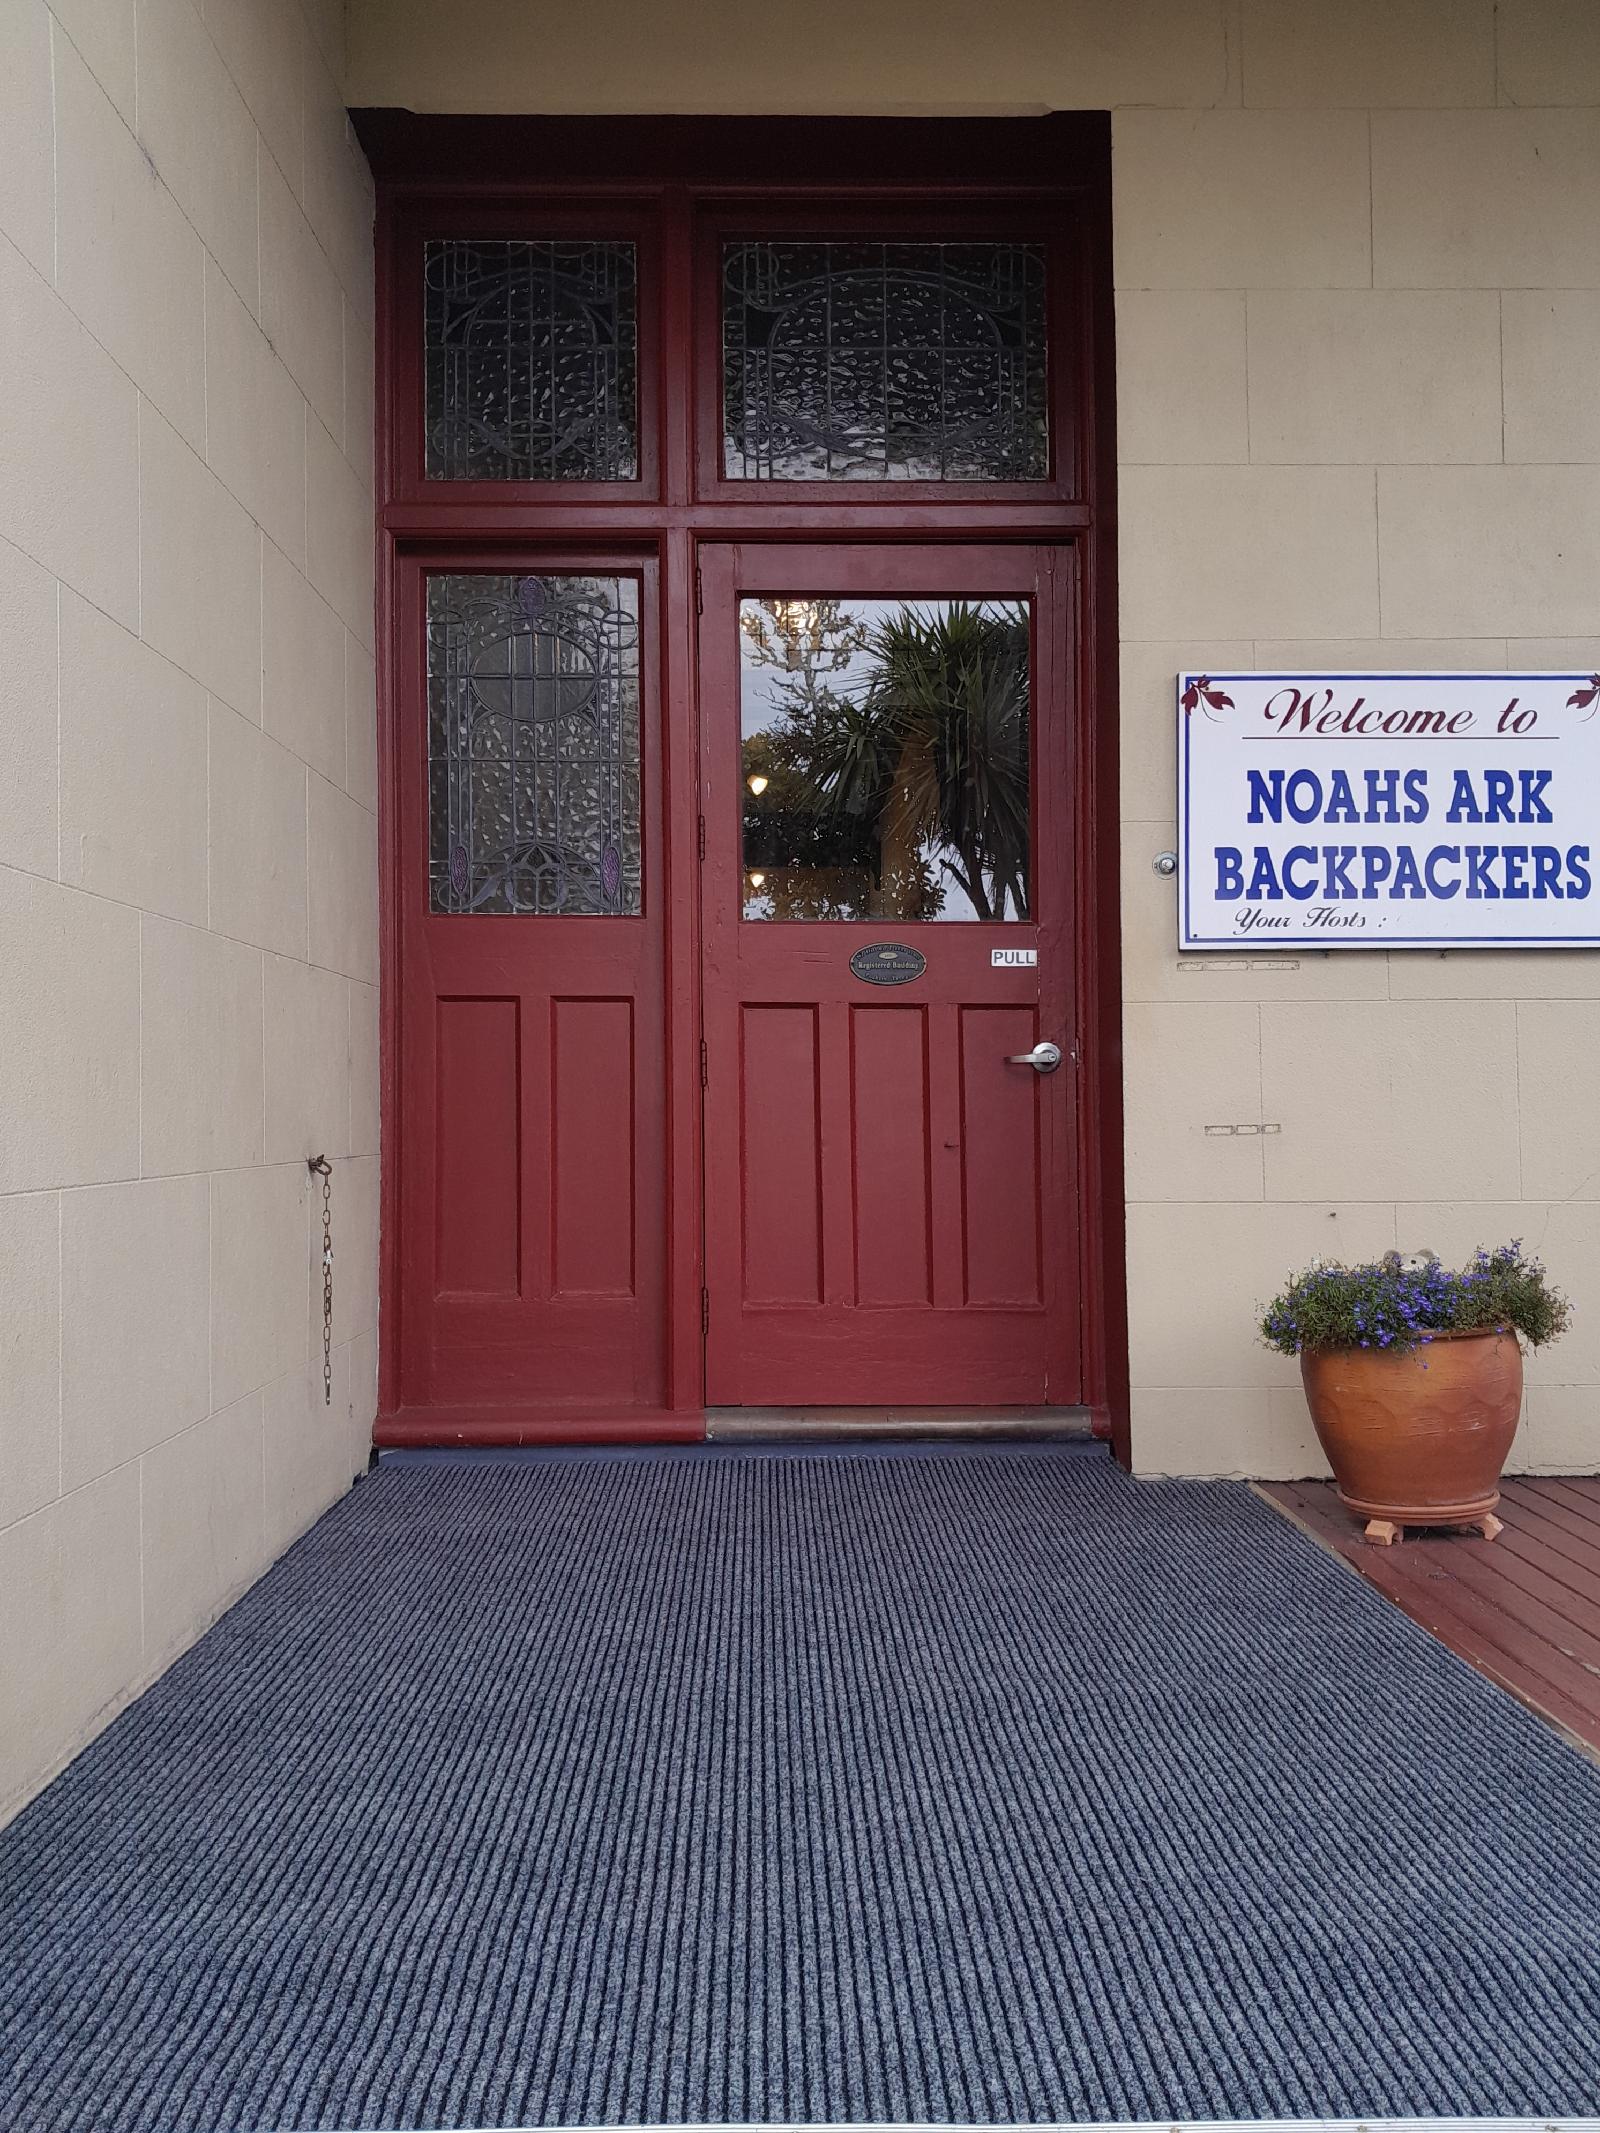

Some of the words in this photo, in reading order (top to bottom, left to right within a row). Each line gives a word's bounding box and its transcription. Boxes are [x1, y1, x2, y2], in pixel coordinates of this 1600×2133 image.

[1264, 688, 1477, 734] Welcome
[1496, 697, 1538, 734] to
[1246, 768, 1430, 824] NOAHS
[1446, 769, 1553, 824] ARK
[1214, 844, 1592, 900] BACKPACKERS
[1232, 907, 1291, 936] Your
[1302, 906, 1366, 928] Hosts
[858, 961, 890, 970] Registered
[993, 951, 1035, 965] PULL
